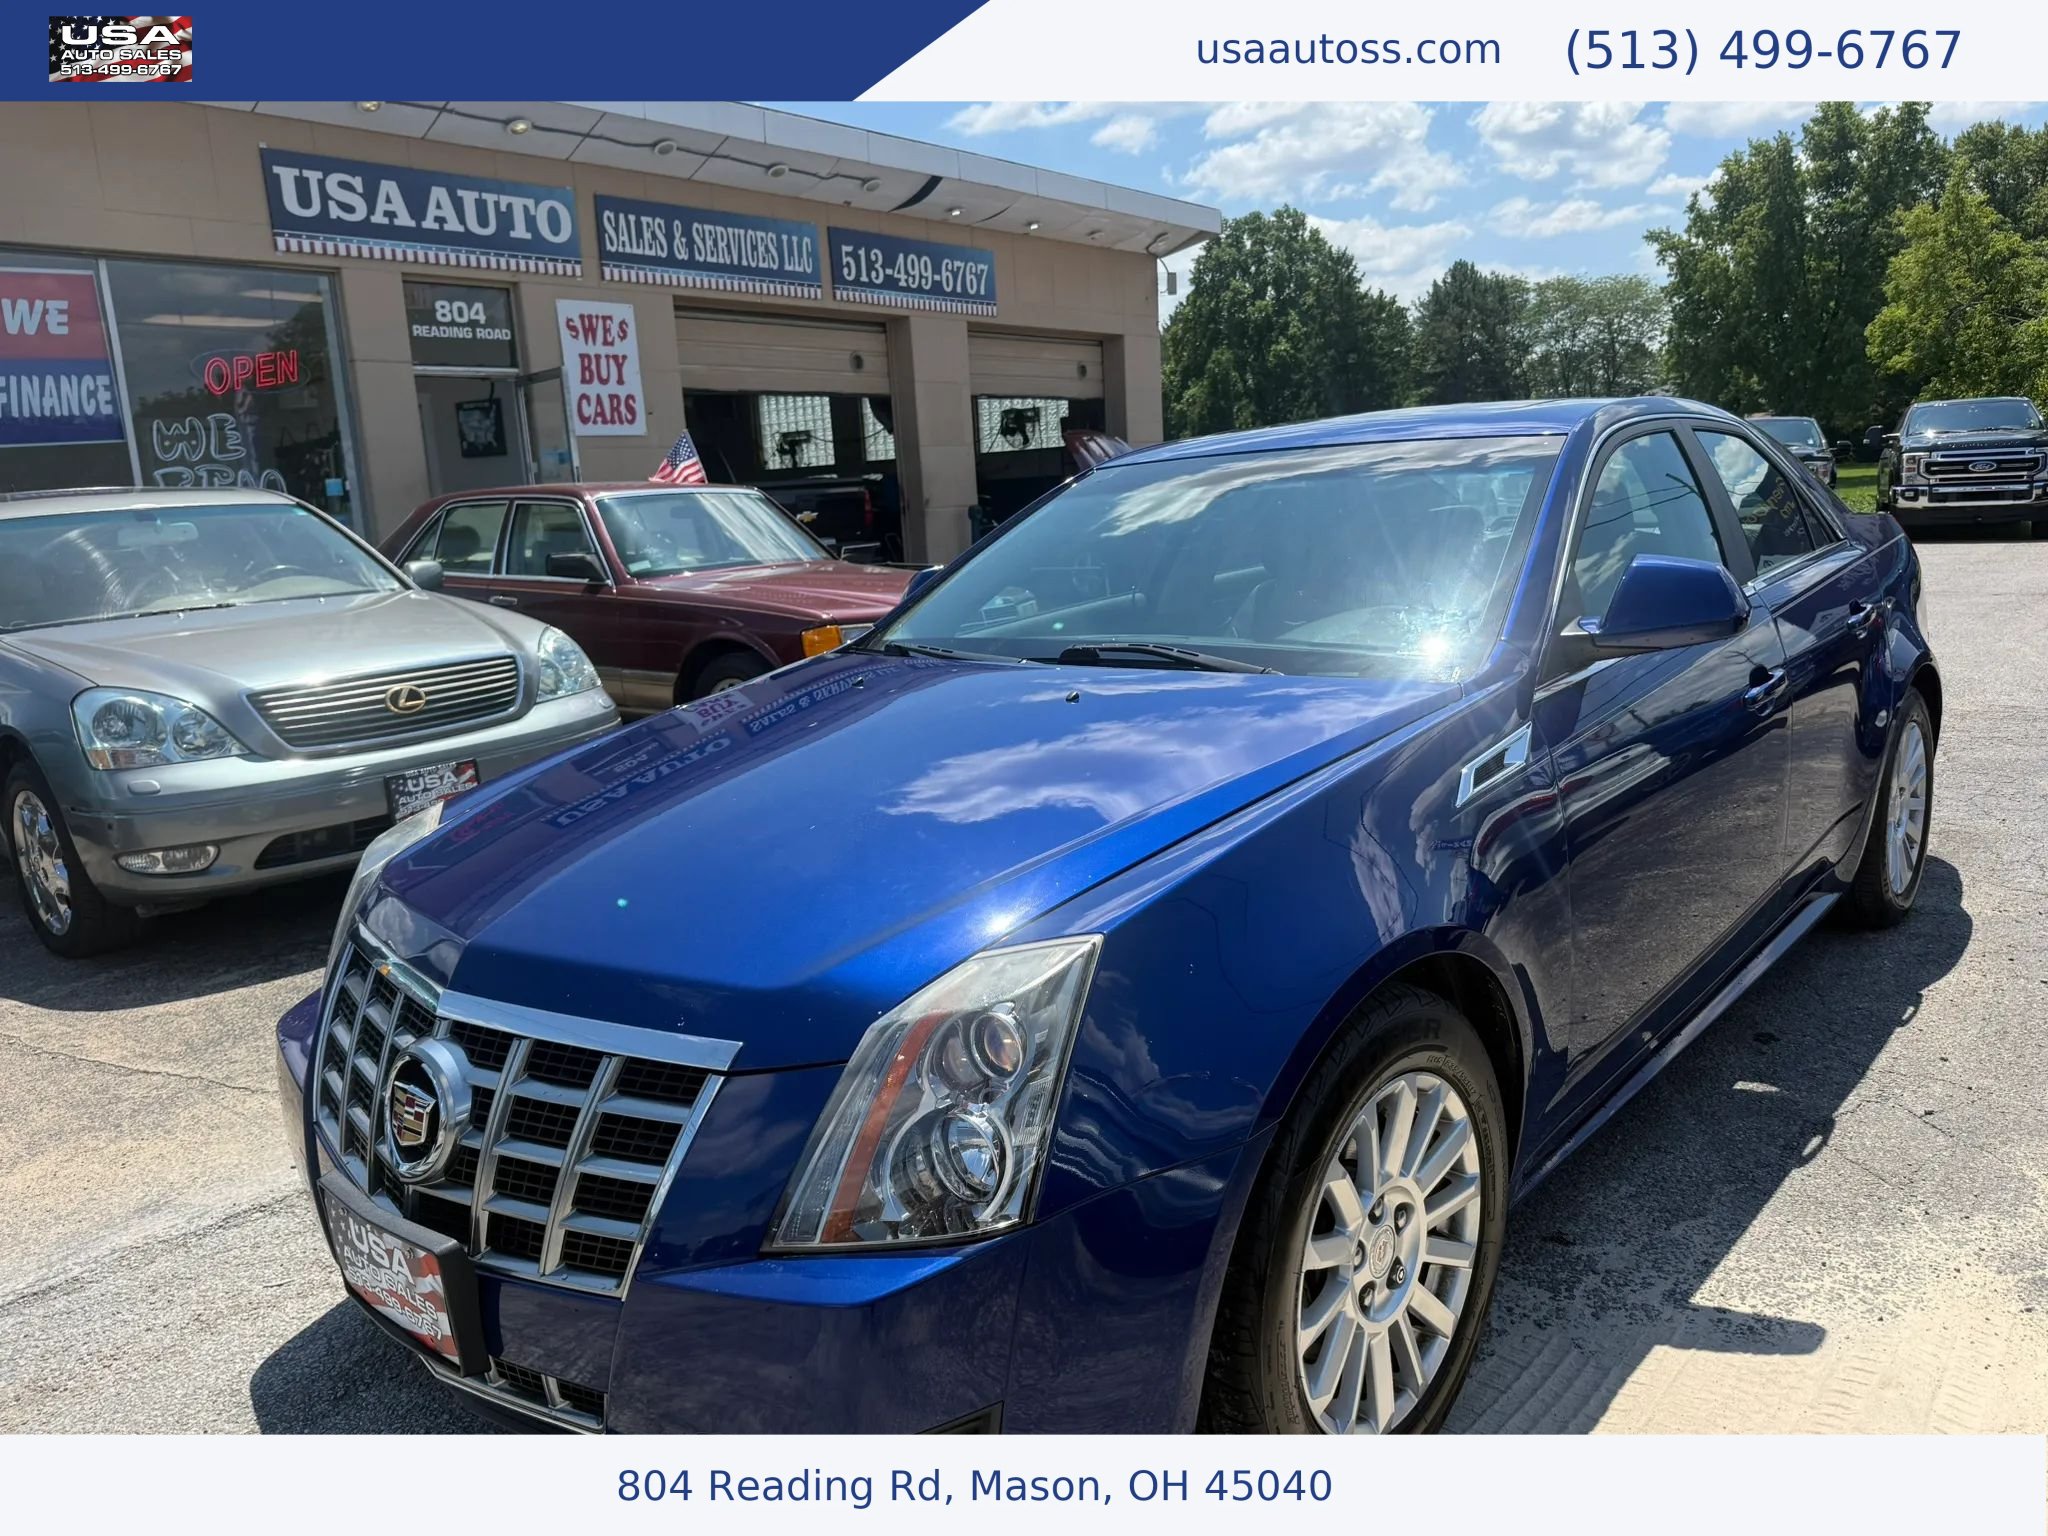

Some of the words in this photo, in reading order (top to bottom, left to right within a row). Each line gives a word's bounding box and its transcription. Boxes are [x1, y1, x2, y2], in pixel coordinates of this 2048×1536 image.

[272, 165, 416, 228] USA
[421, 186, 573, 244] AUTO
[603, 210, 669, 258] SALES
[672, 219, 690, 261] &
[692, 223, 780, 270] SERVICES
[780, 232, 815, 274] LLC
[841, 245, 990, 296] 513-499-6767
[1, 298, 69, 335] WE
[412, 324, 473, 339] READING
[476, 328, 511, 340] ROAD
[434, 300, 486, 324] 804
[205, 350, 298, 395] OPEN
[578, 353, 628, 386] BUY
[577, 394, 637, 425] CARS
[153, 413, 247, 461] WE
[398, 787, 434, 806] AUTO
[407, 770, 458, 793] USA
[349, 1216, 416, 1287] USA
[343, 1246, 382, 1284] AUTO
[384, 1272, 438, 1323] SALES
[347, 1267, 441, 1341] 513-499-6767
